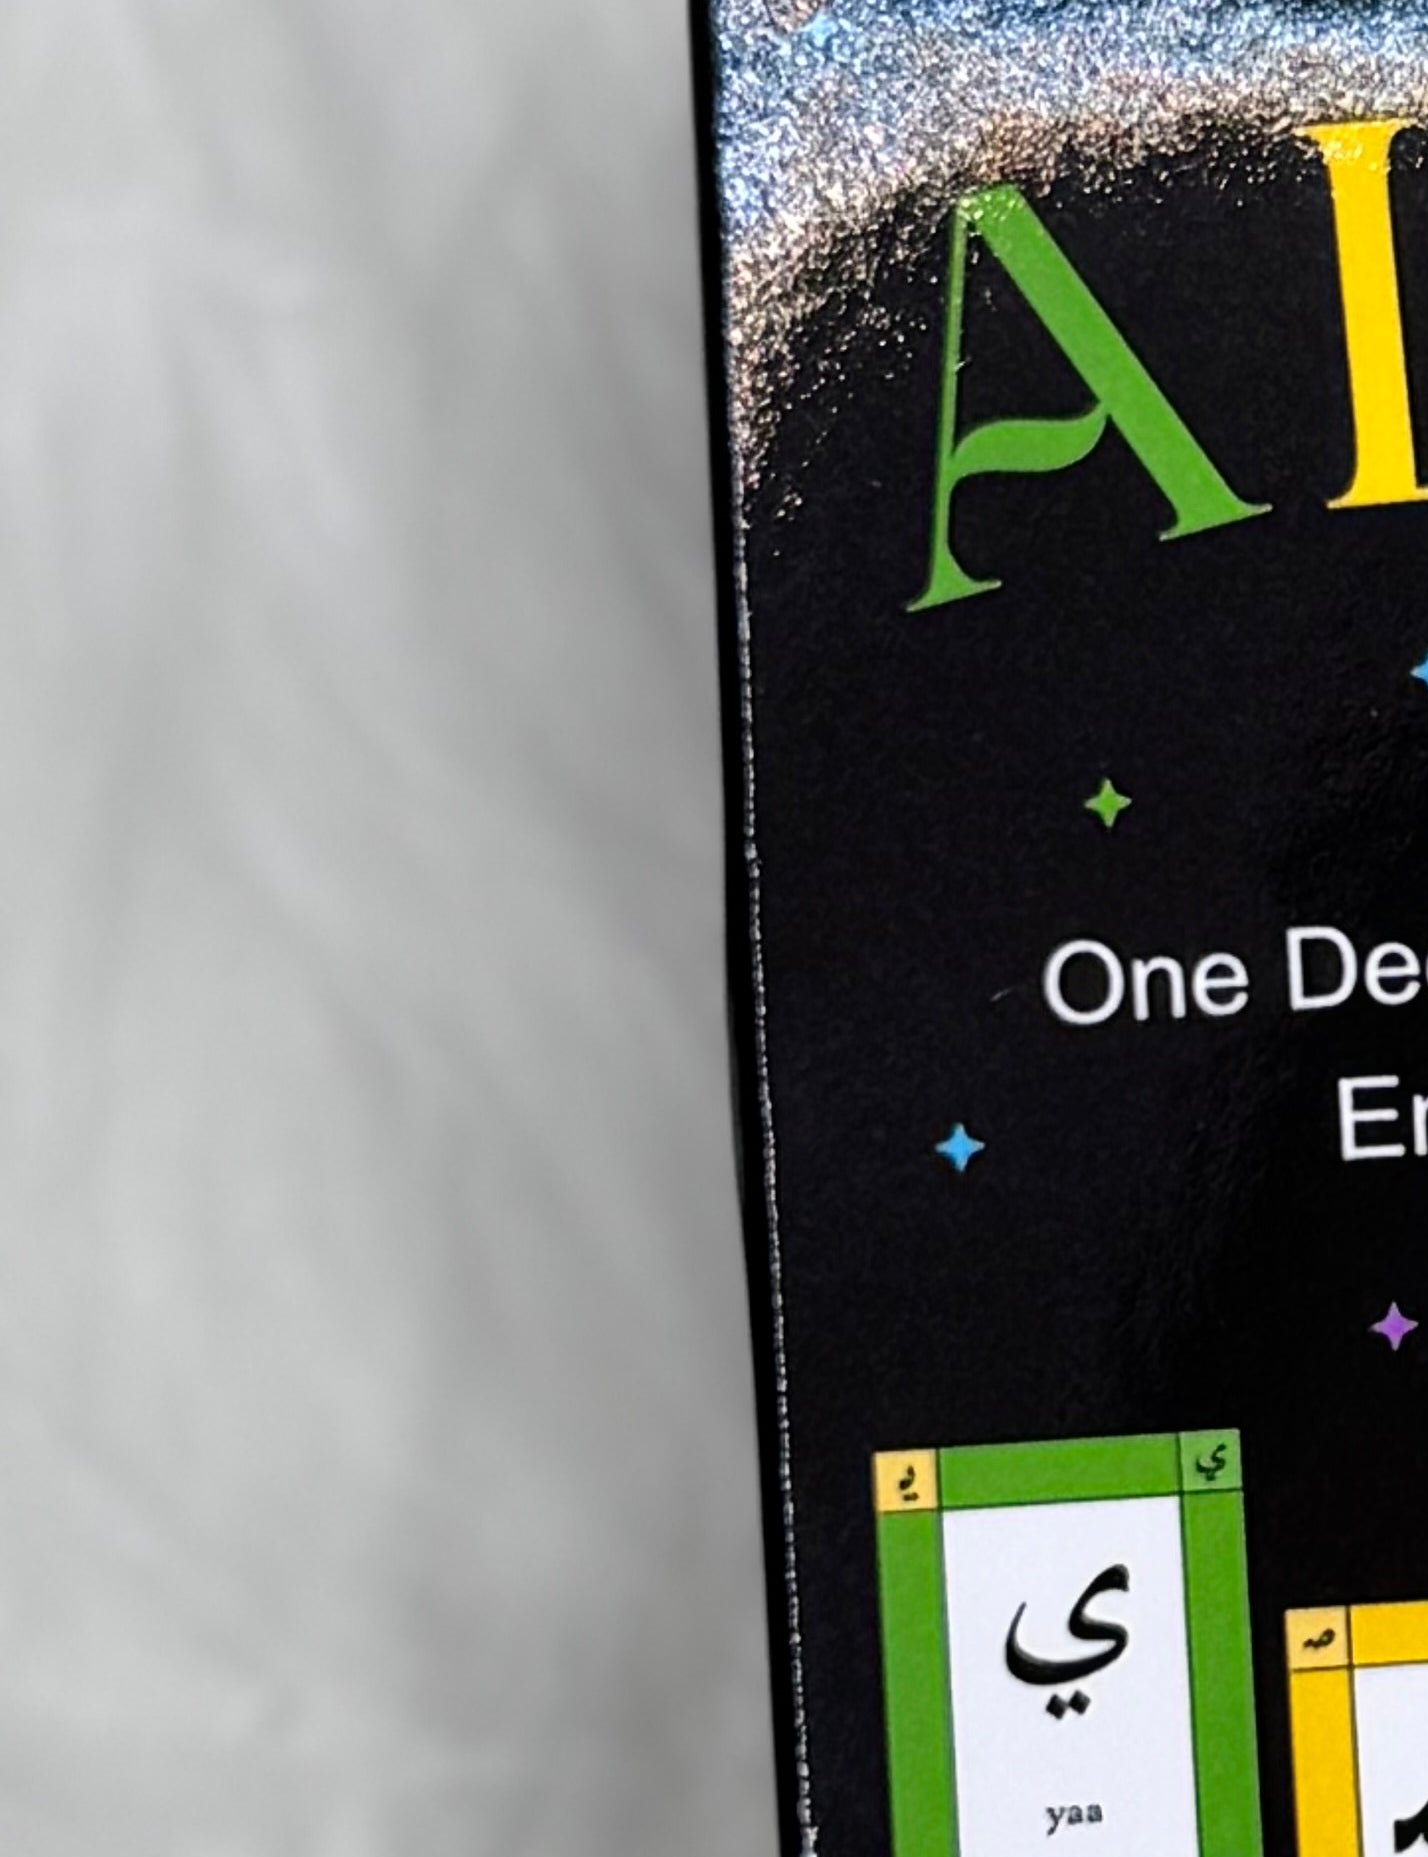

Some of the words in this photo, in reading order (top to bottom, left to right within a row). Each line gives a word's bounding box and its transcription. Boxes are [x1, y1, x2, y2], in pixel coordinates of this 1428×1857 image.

[1044, 939, 1249, 1025] One
[1004, 1564, 1130, 1720] ي
[1045, 1804, 1103, 1837] yaa
